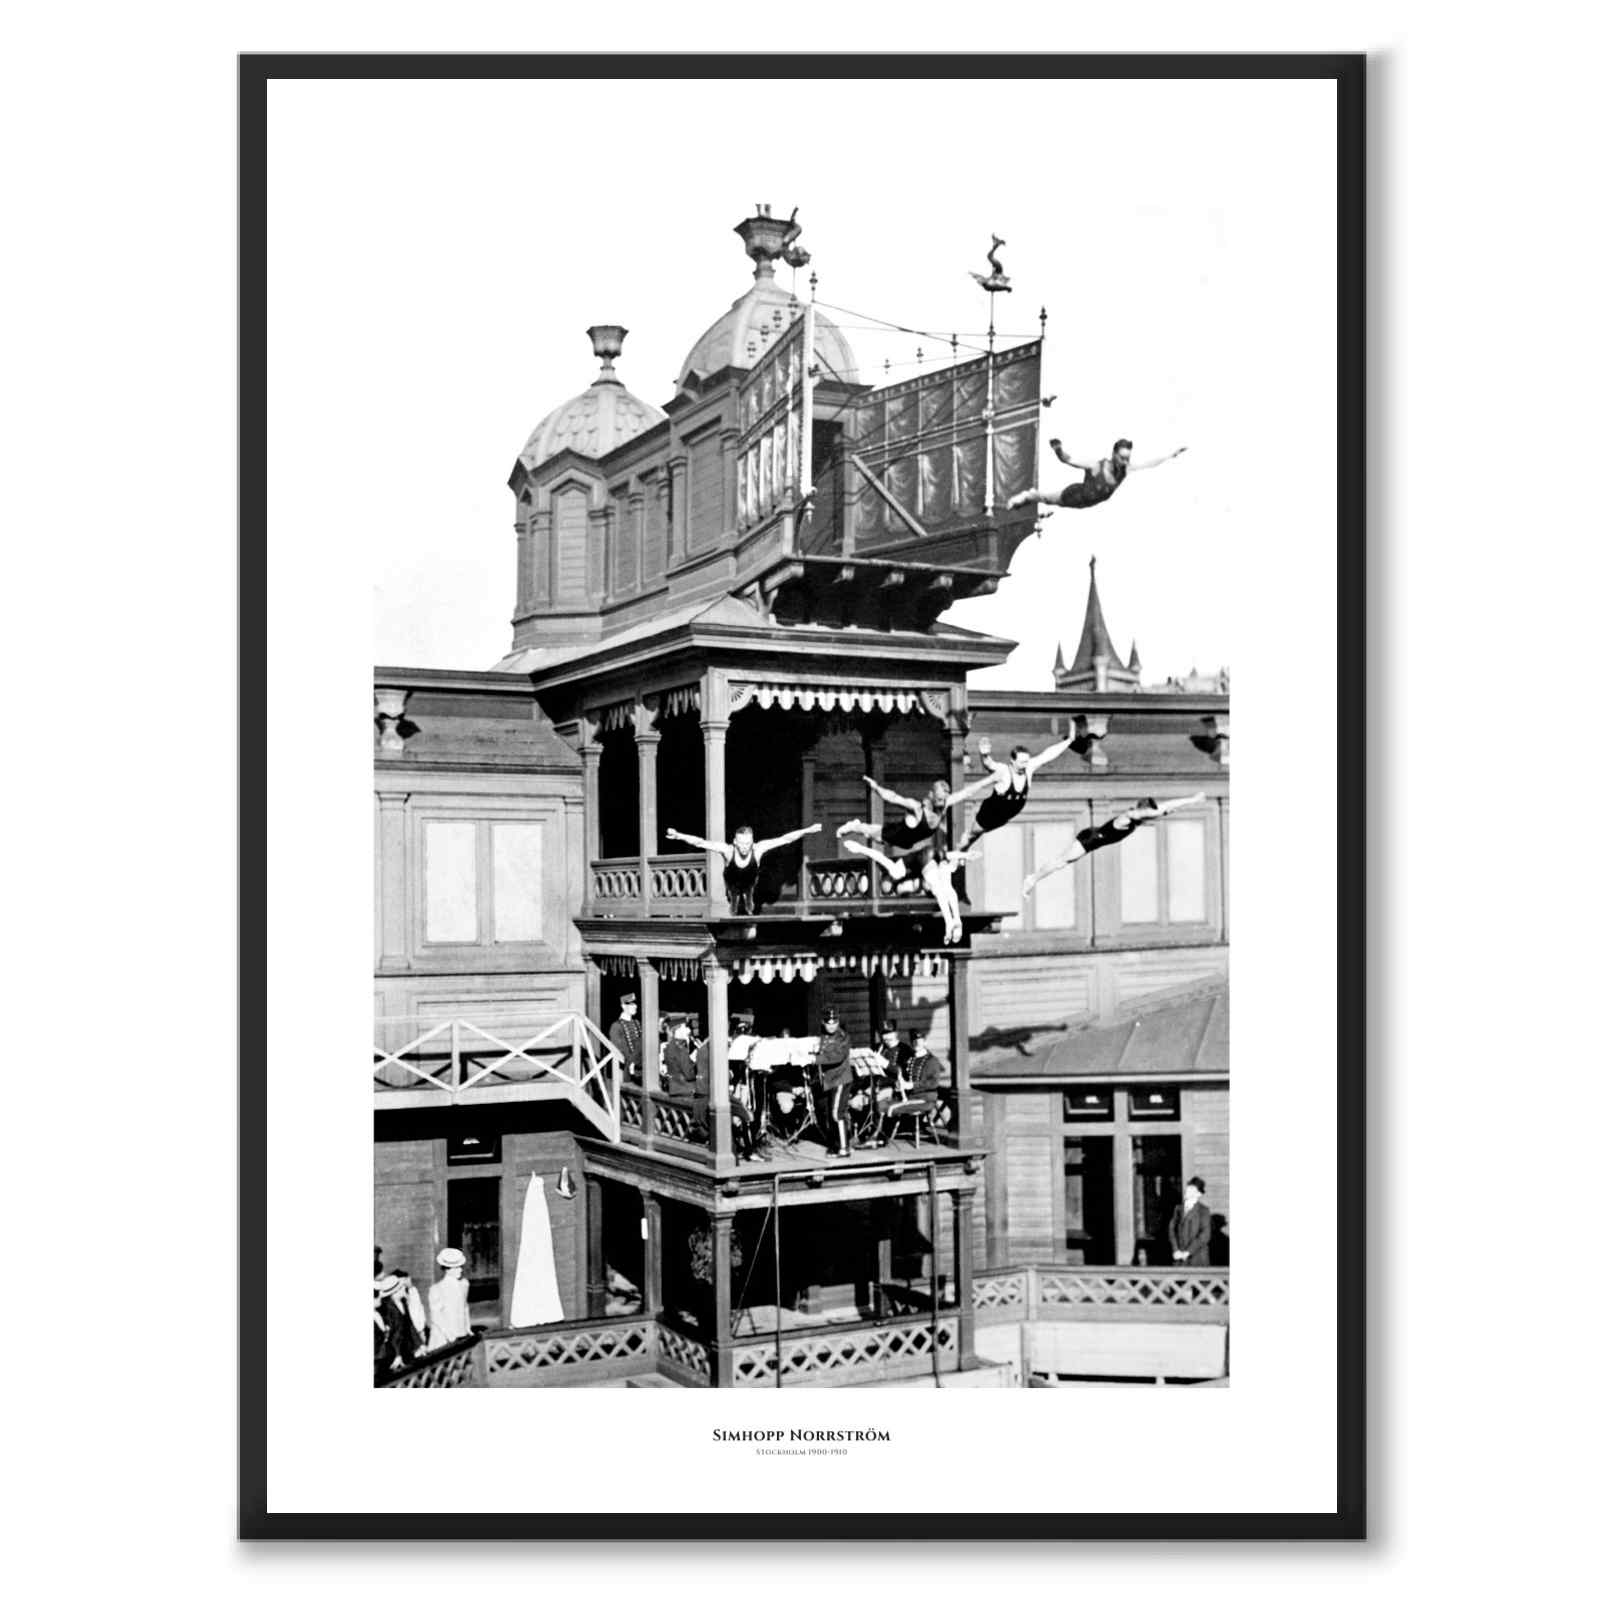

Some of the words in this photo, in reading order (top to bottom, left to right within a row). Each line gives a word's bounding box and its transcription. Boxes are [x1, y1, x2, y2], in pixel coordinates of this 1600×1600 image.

[712, 1428, 785, 1441] SIMHOPP
[756, 1448, 806, 1456] STOCKHOLM
[808, 1448, 848, 1456] 1900-1910
